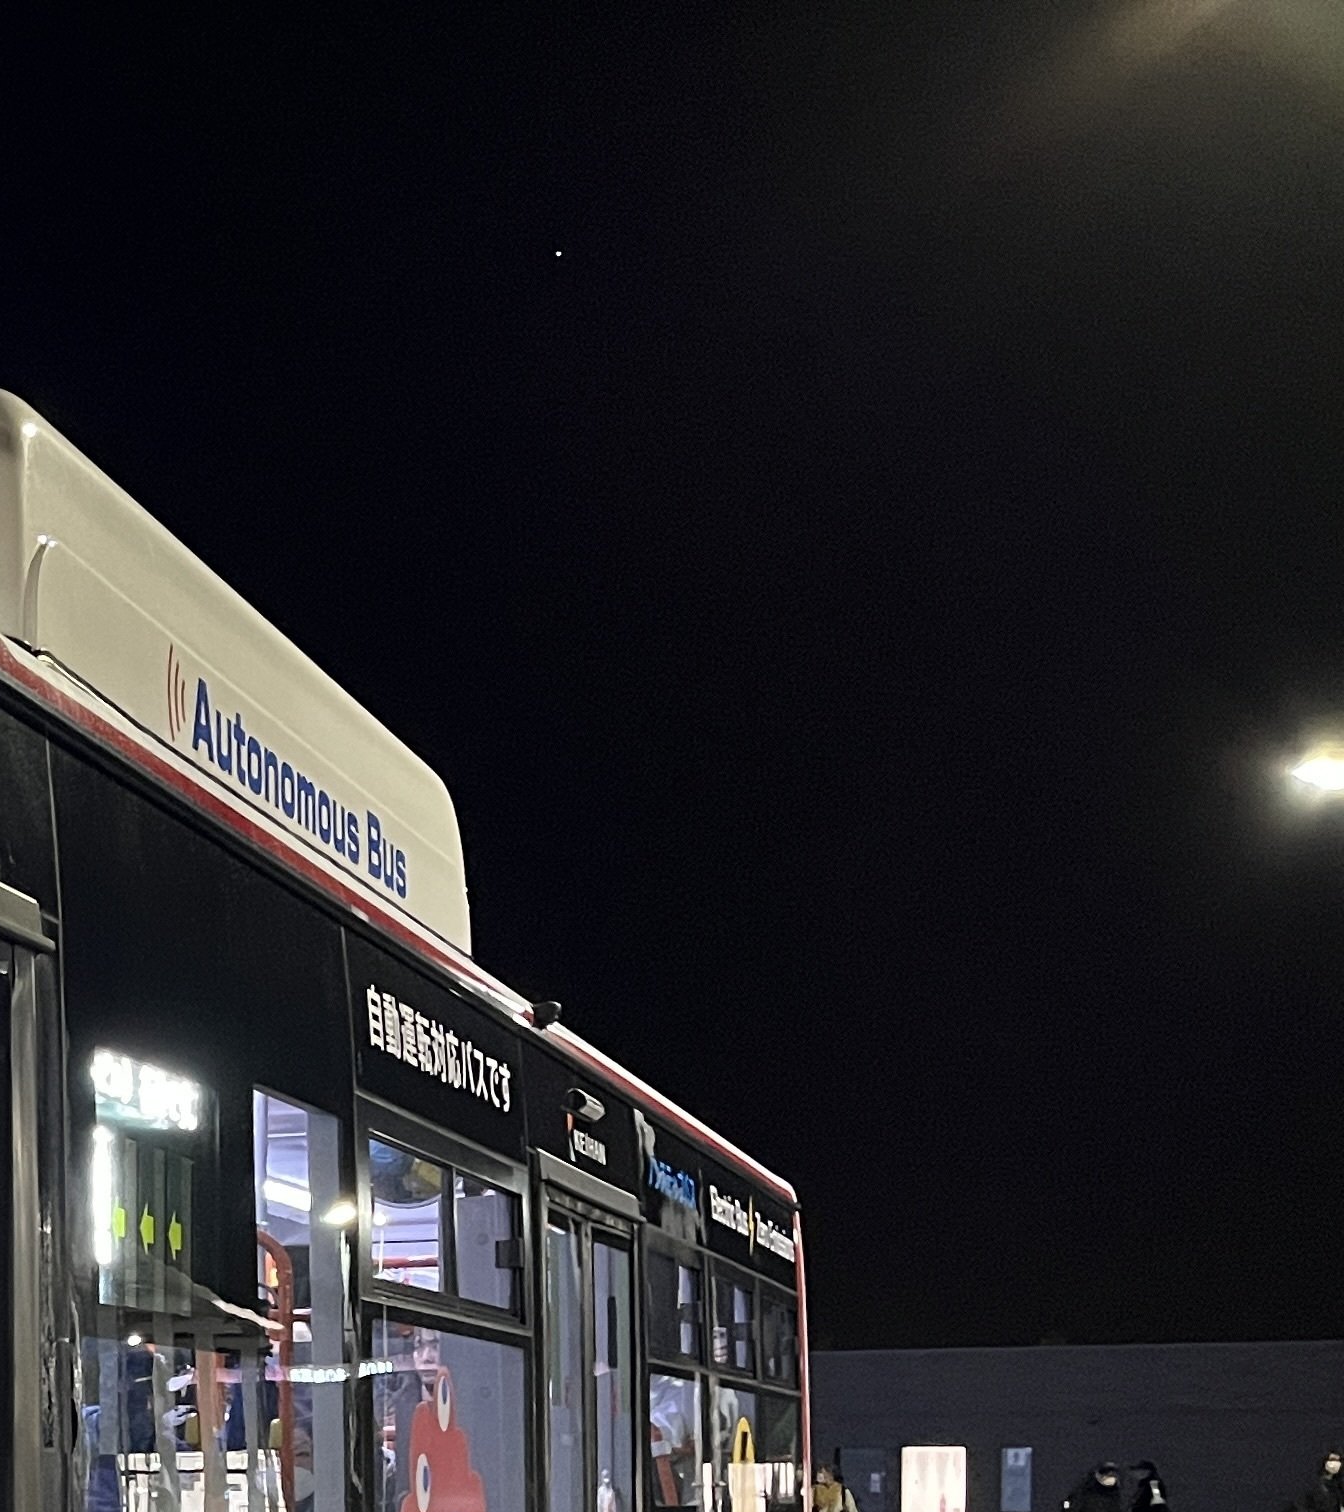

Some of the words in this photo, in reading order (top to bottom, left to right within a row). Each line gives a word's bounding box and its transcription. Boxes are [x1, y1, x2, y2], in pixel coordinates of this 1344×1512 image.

[192, 676, 360, 865] Autonomous
[366, 809, 408, 900] Bus
[366, 984, 511, 1113] 自動運転対応バスです
